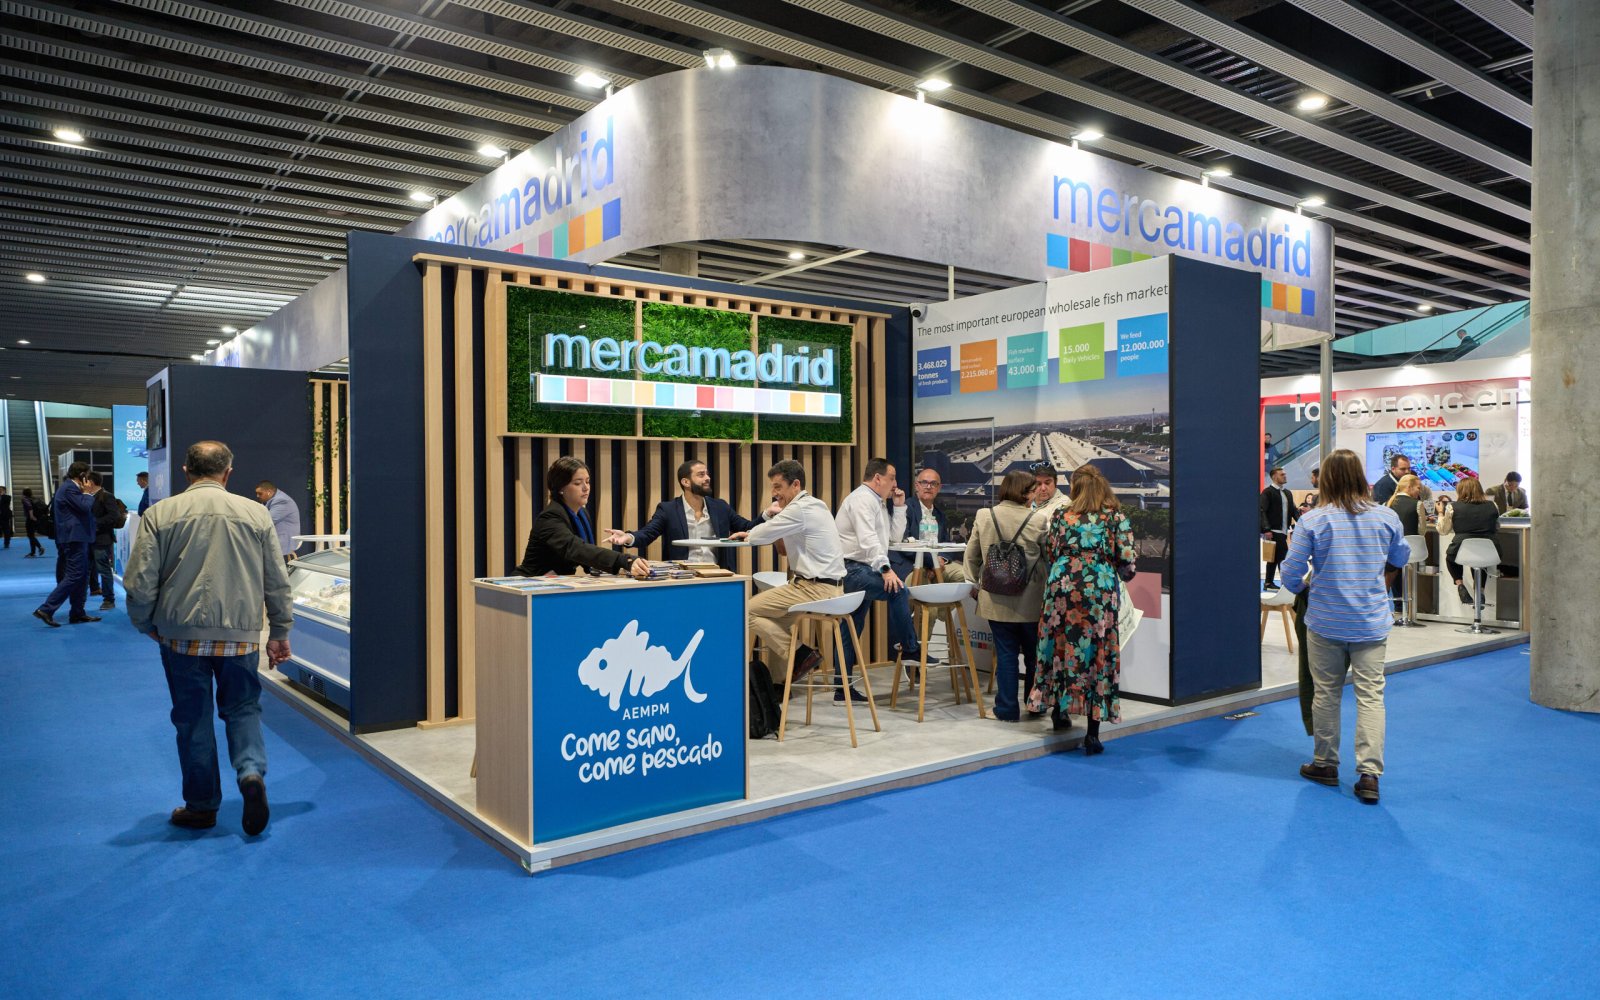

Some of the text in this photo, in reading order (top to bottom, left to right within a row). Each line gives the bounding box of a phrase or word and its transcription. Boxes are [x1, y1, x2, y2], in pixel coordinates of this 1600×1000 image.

[1053, 175, 1311, 278] mercamadrid
[917, 284, 1168, 336] The most important european wholesale fish market
[1064, 343, 1090, 354] 15.000
[1120, 340, 1165, 352] 12.000.000
[542, 332, 834, 386] mercamadrid
[918, 360, 948, 370] 3.468.029
[1120, 354, 1140, 363] people
[918, 372, 938, 380] tonnes
[1008, 364, 1035, 376] 43.000
[1396, 416, 1446, 429] KOREA
[622, 702, 670, 720] AEMPM
[560, 728, 620, 762] Come
[578, 733, 722, 783] come pescado
